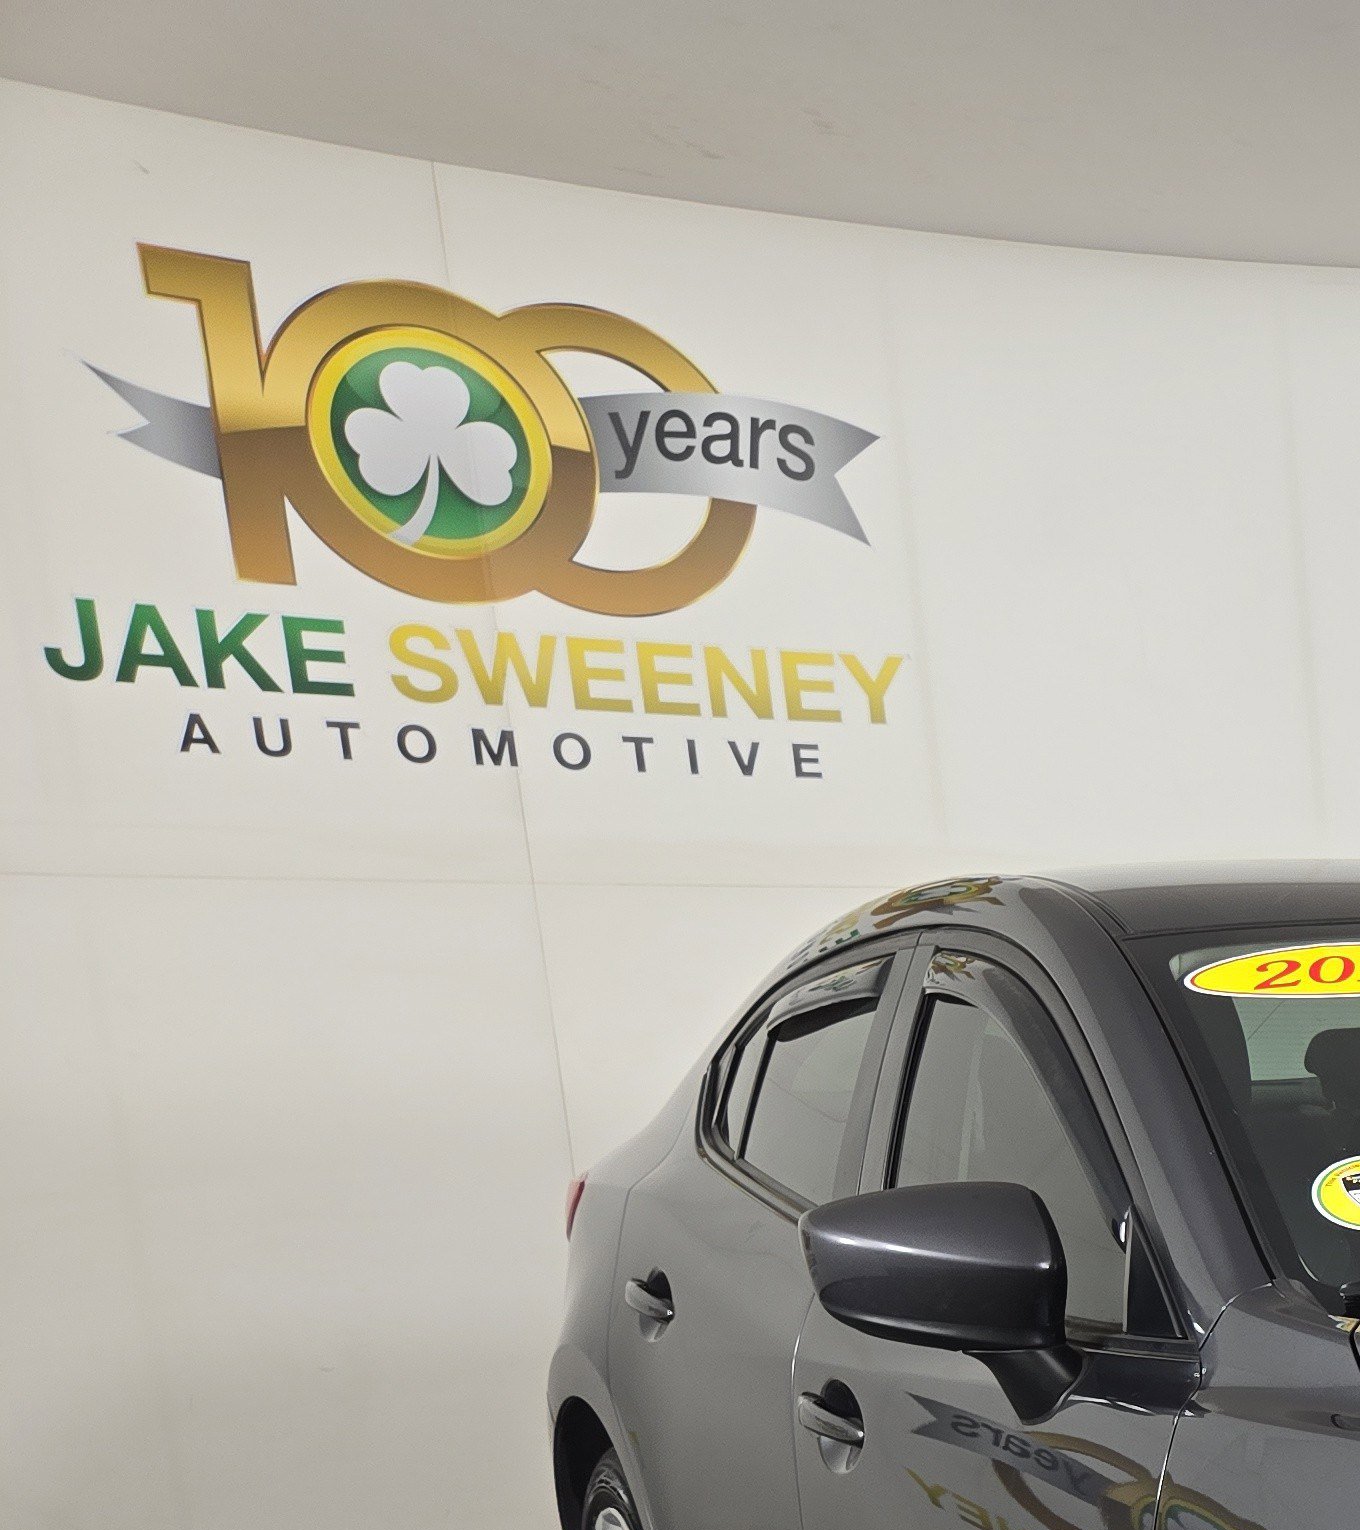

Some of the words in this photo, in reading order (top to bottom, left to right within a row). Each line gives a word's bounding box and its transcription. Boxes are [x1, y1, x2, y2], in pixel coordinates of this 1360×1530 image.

[137, 242, 758, 618] 100
[608, 408, 817, 483] years
[43, 597, 356, 698] JAKE
[387, 625, 905, 726] SWEENEY
[180, 712, 825, 780] AUTOMOTIVE
